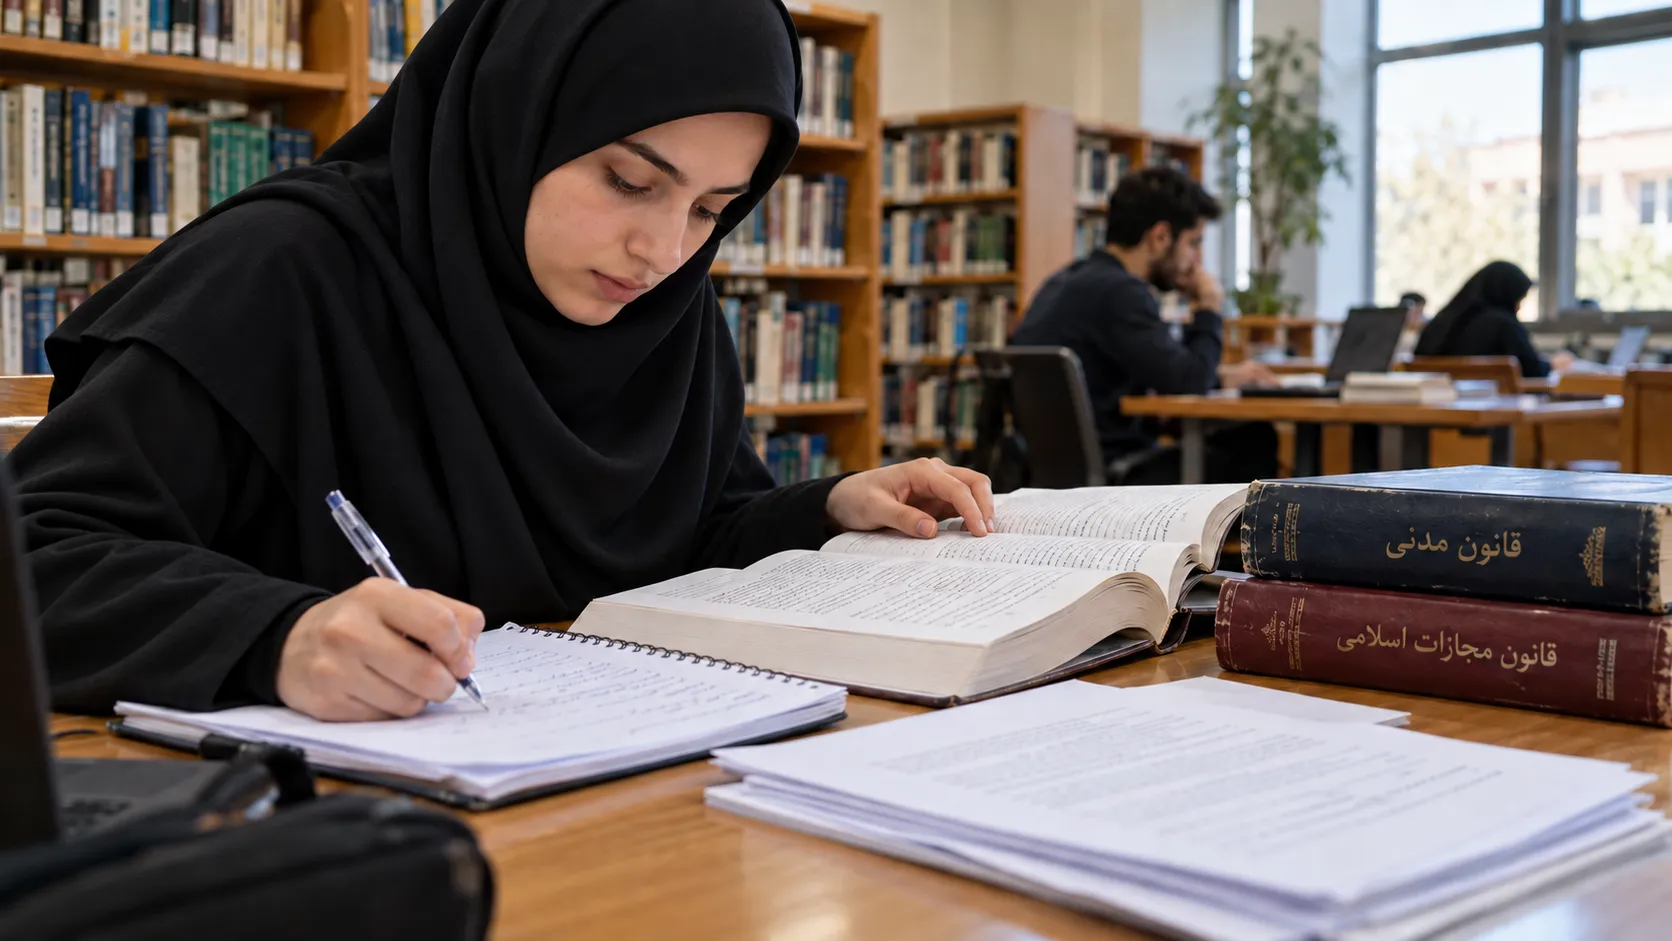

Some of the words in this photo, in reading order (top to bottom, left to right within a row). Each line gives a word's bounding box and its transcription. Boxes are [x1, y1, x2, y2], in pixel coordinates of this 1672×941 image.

[1385, 527, 1449, 559] مدنی
[1458, 530, 1522, 566] قانون
[1336, 623, 1407, 652] اسلامی
[1414, 630, 1493, 664] مجازات
[1500, 641, 1558, 673] قانون
